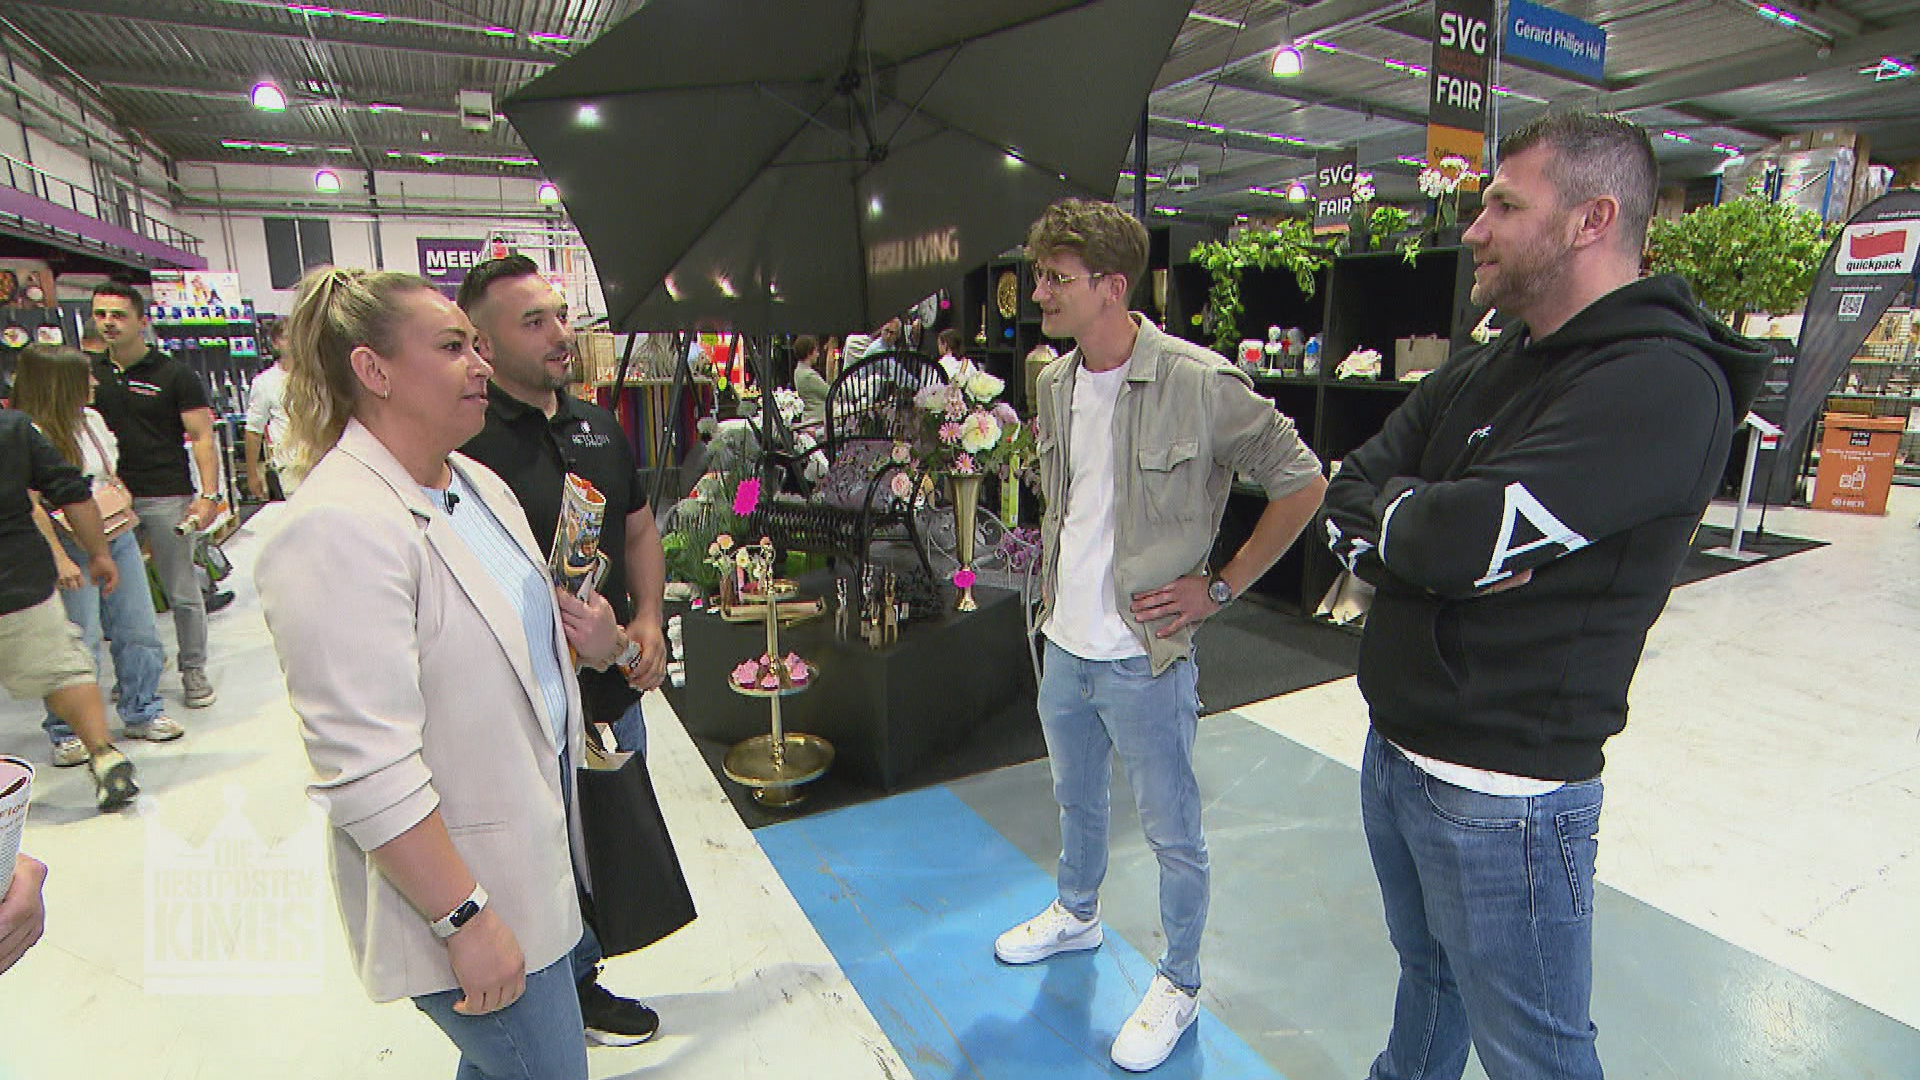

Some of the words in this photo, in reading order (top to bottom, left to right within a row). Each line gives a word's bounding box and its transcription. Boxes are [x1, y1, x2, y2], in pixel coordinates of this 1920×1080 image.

[1440, 13, 1487, 55] SVG
[1515, 19, 1552, 46] Gerard
[1436, 75, 1482, 111] FAIR
[1320, 164, 1353, 187] SVG
[1318, 198, 1352, 217] FAIR
[1846, 258, 1902, 272] quickpack
